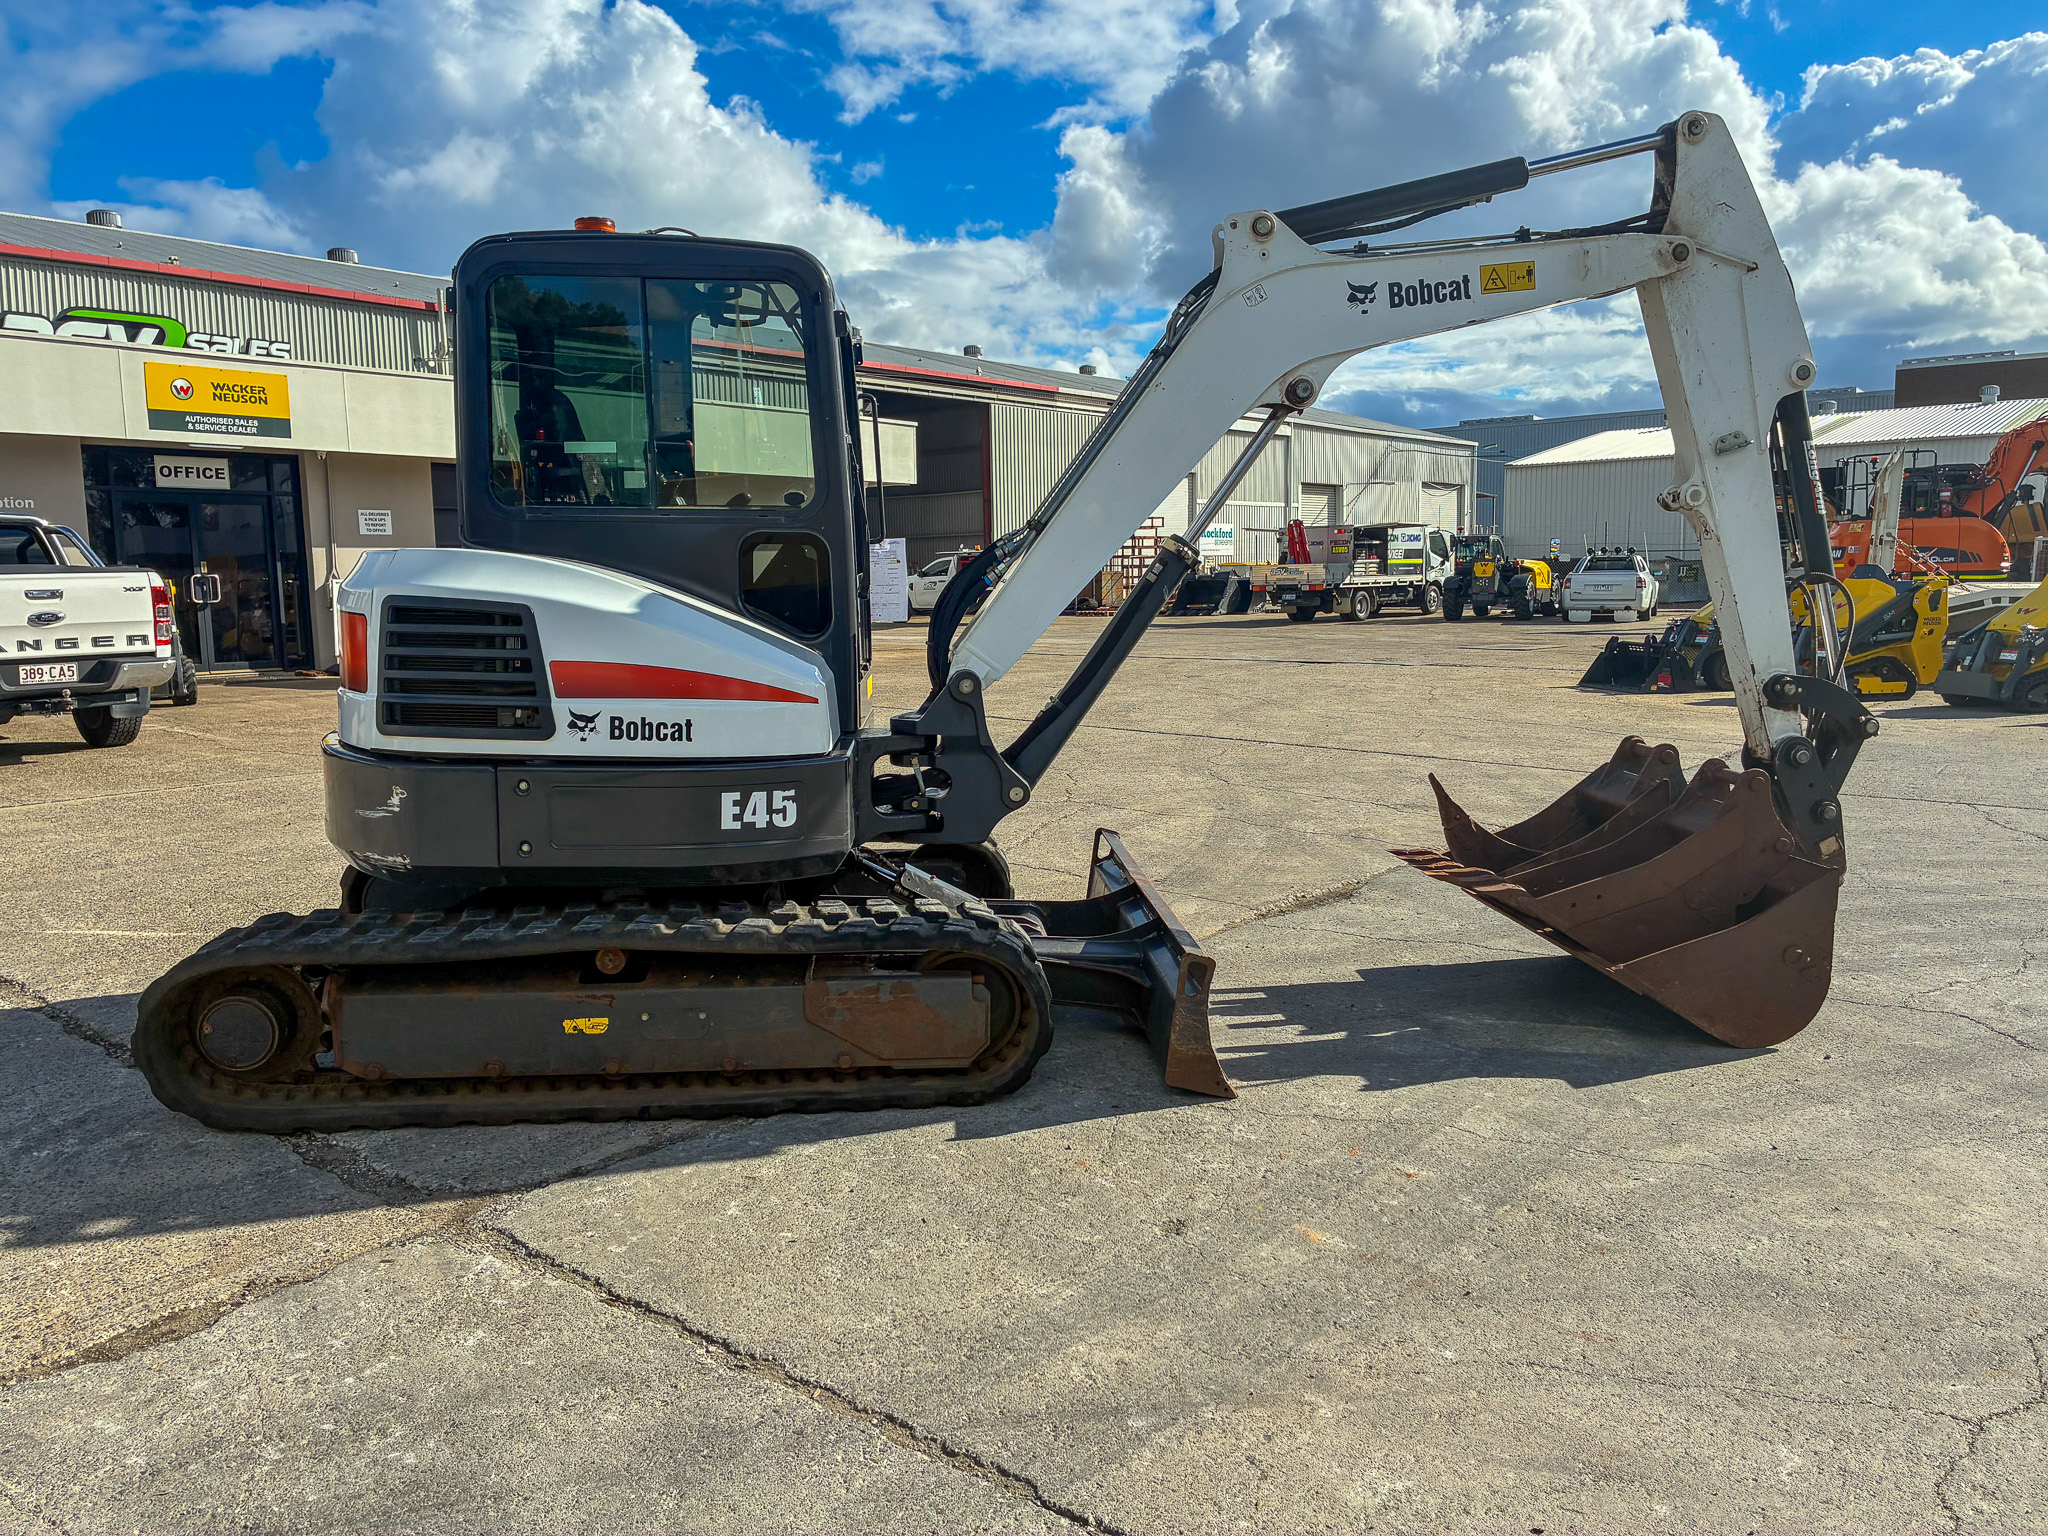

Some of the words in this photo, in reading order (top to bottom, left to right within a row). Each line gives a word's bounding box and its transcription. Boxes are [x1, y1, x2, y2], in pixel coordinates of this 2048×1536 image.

[1388, 274, 1472, 309] Bobcat
[210, 381, 267, 396] WACKER
[212, 392, 268, 406] NEUSON
[185, 415, 234, 426] AUTHORISED
[234, 418, 259, 427] SALES
[187, 422, 194, 430] &
[195, 423, 227, 433] SERVICE
[228, 424, 257, 434] DEALER
[159, 465, 226, 480] OFFICE
[609, 715, 694, 743] Bobcat
[721, 789, 797, 831] E45
